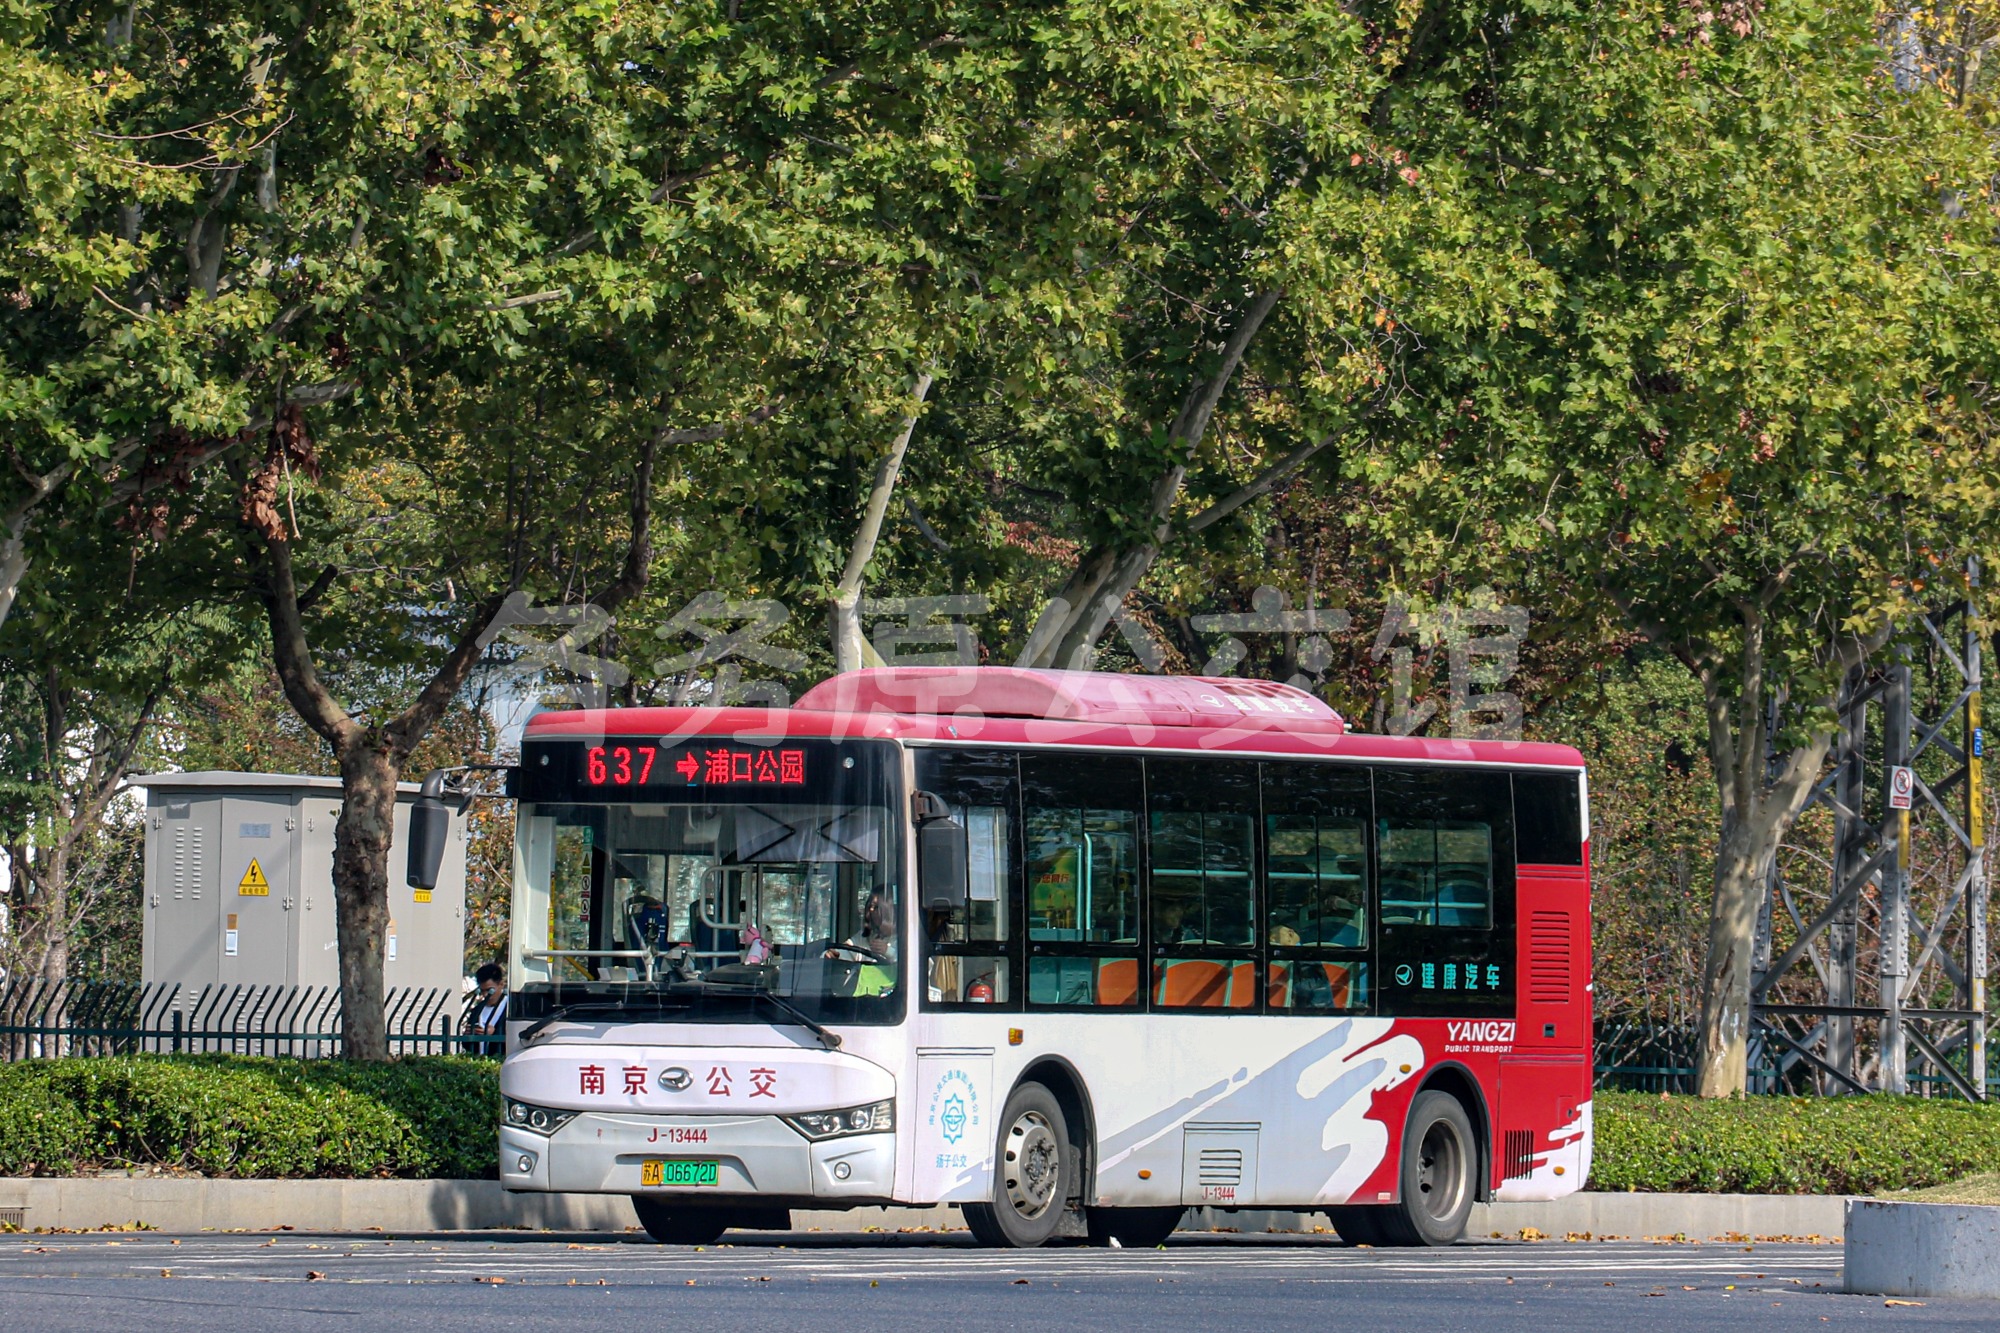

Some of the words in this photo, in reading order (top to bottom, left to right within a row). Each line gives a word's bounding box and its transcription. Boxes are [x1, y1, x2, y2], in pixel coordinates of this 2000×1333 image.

[588, 746, 656, 785] 637
[705, 749, 803, 785] 浦口公园
[1447, 1021, 1516, 1042] YANGZI
[1445, 1044, 1470, 1053] PUBLIC
[1472, 1045, 1513, 1054] TRANSPORT
[647, 1127, 708, 1144] J-13444
[1202, 1186, 1236, 1201] J-13444
